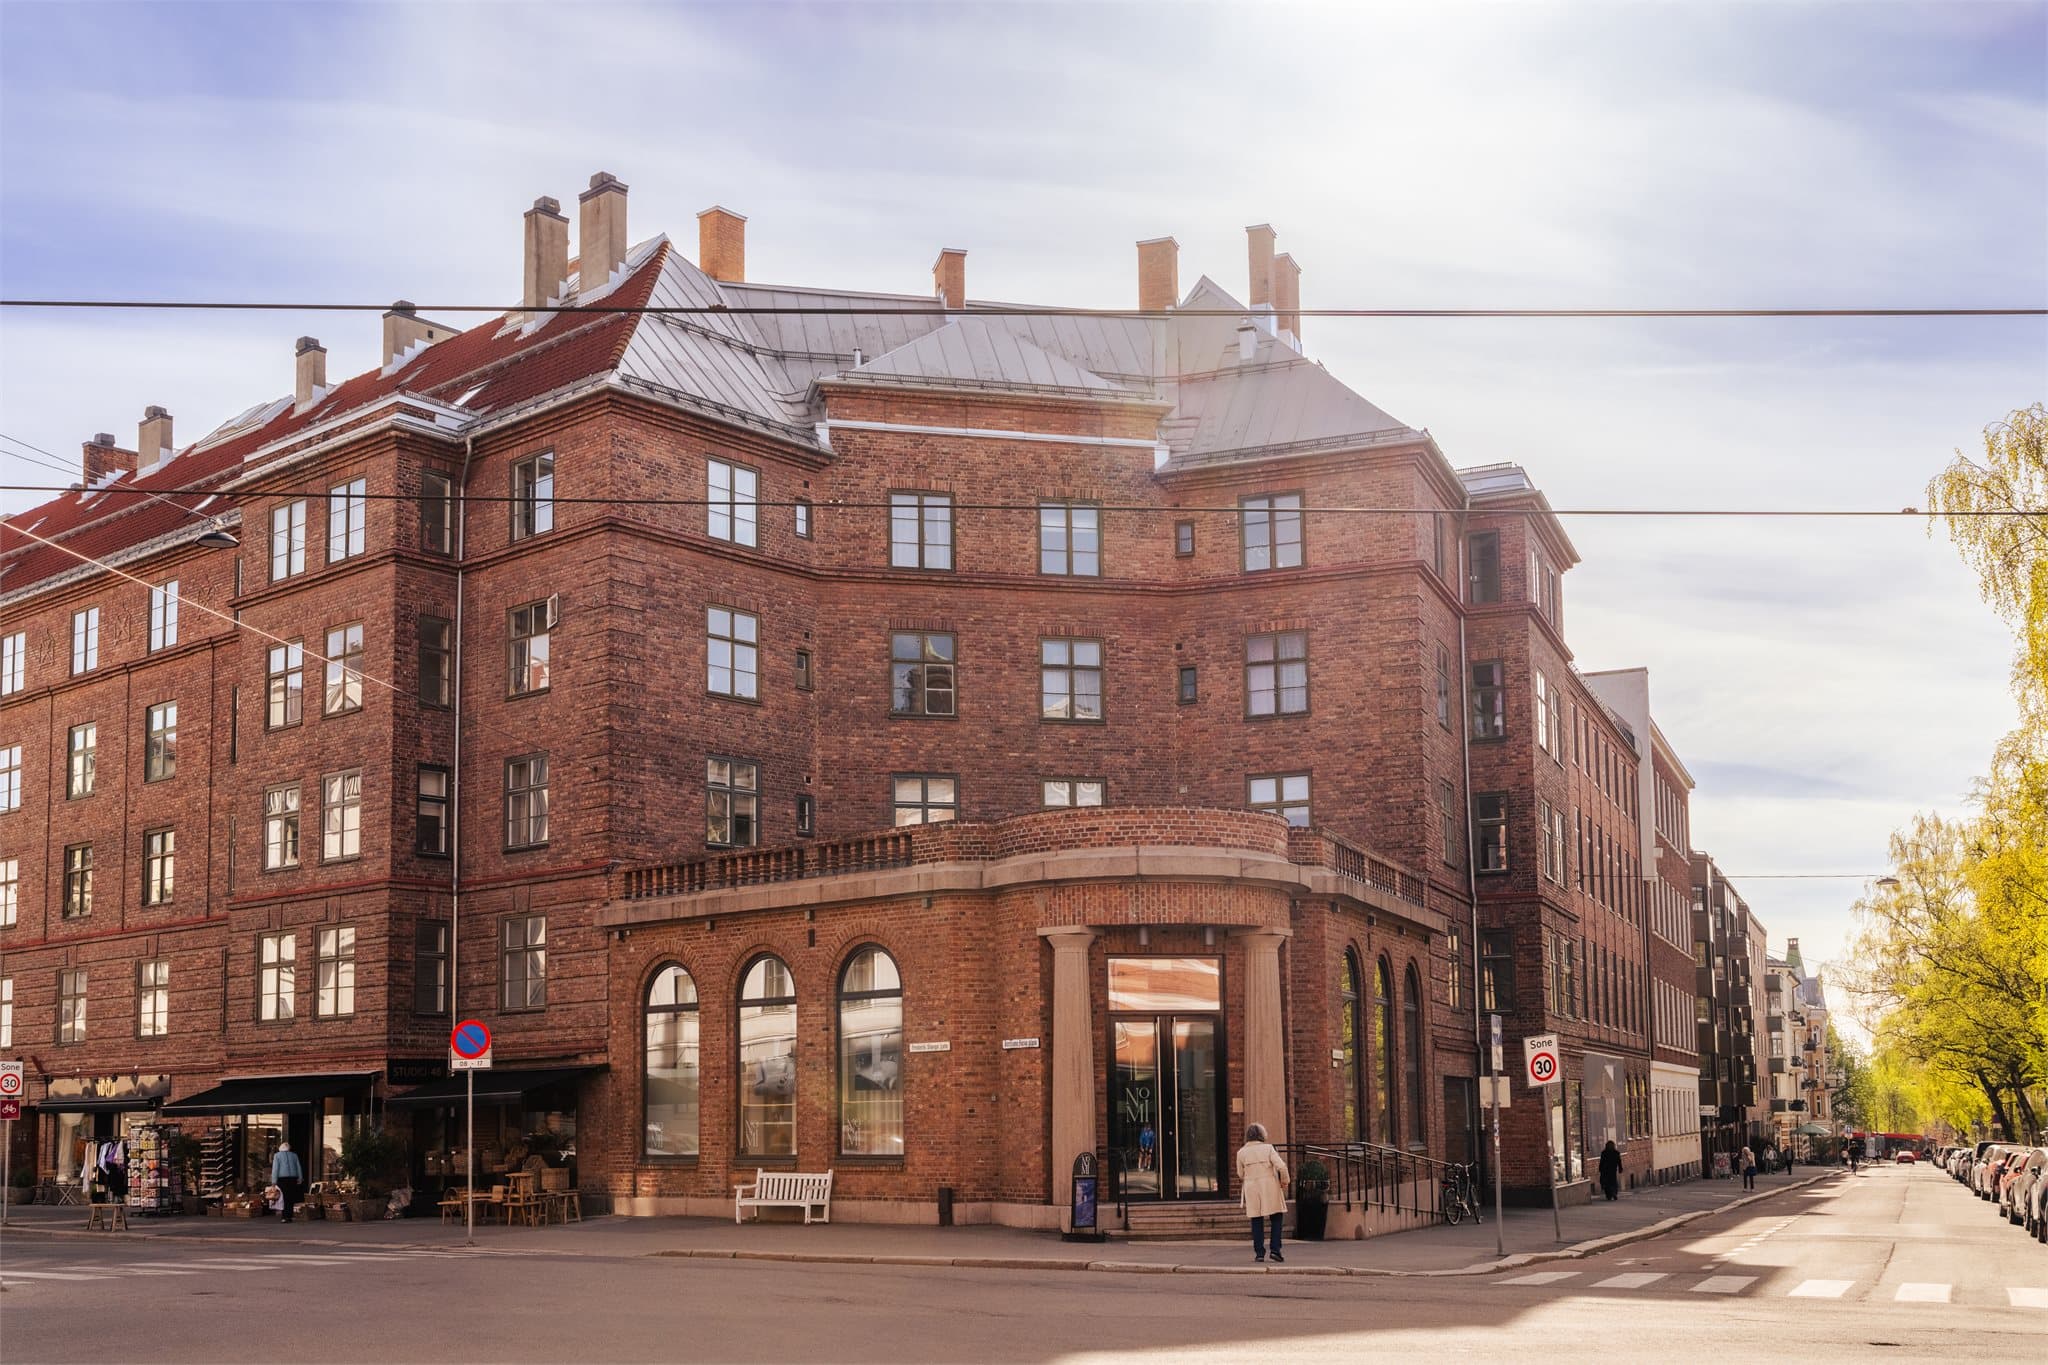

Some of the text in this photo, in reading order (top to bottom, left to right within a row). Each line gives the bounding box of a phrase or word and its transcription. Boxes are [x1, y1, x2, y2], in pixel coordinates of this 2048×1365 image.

[1529, 1039, 1553, 1049] Sone
[1, 1063, 21, 1071] Sone
[1535, 1059, 1552, 1075] 30
[3, 1079, 17, 1088] 30
